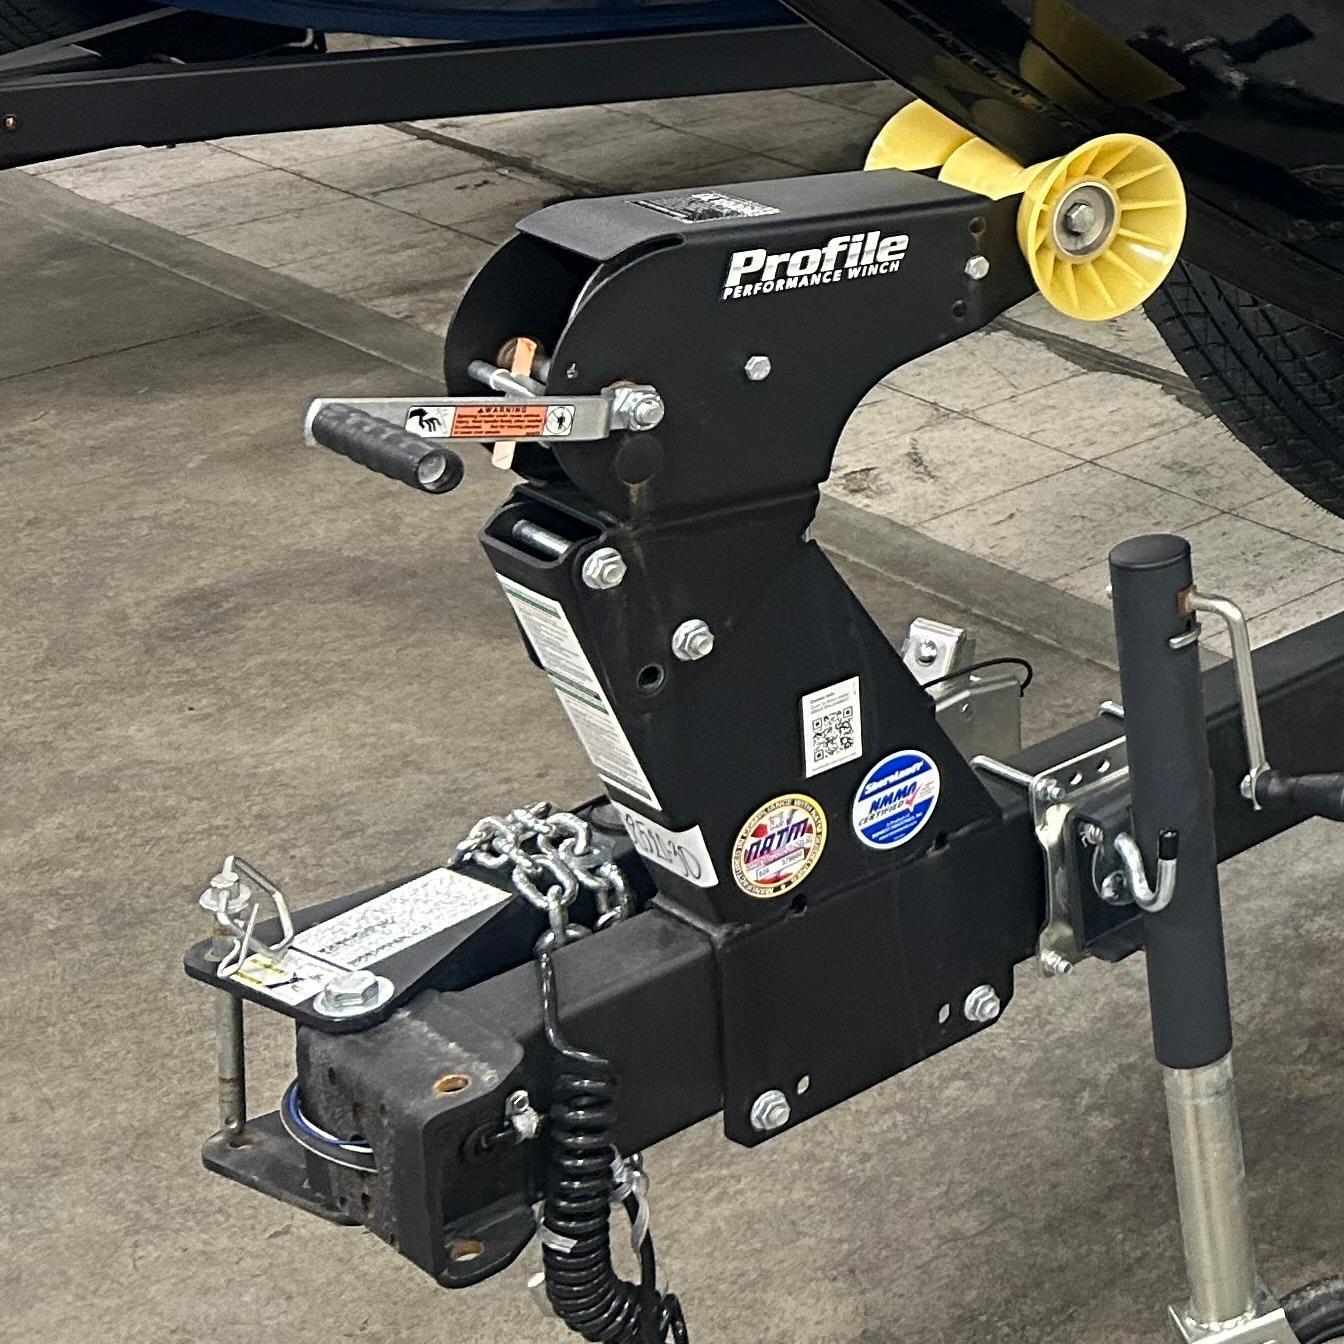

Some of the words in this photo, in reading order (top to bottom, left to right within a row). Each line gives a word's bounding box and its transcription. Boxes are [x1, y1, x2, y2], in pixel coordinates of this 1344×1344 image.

[724, 230, 910, 288] Profile
[721, 269, 843, 301] PERFORMANCE
[847, 260, 900, 280] WINCH
[869, 781, 918, 815] NMMA
